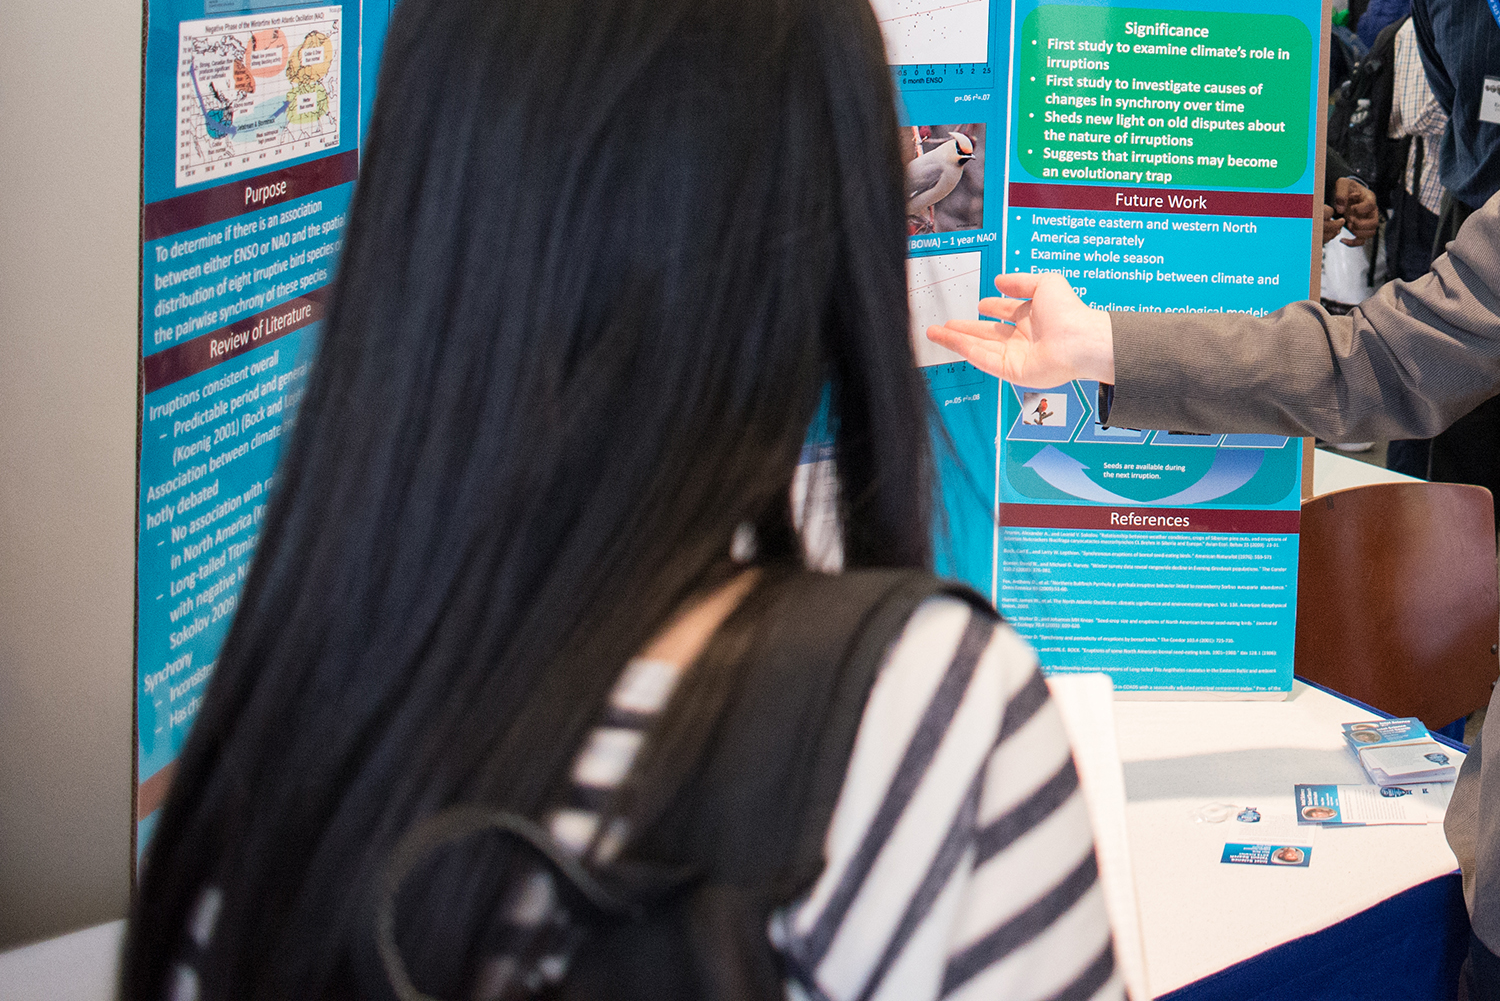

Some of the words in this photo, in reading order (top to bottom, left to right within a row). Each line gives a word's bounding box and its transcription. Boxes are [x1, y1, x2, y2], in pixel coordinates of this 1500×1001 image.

[1125, 21, 1208, 37] Significance
[1048, 38, 1075, 50] First
[1078, 40, 1113, 54] study
[1116, 42, 1130, 52] to
[1133, 43, 1187, 55] examine
[1250, 47, 1274, 59] role
[1278, 48, 1289, 59] in
[245, 181, 286, 204] Purpose
[1116, 193, 1163, 207] Future
[1168, 195, 1206, 208] Work
[155, 246, 168, 262] To
[170, 232, 222, 258] determine
[224, 224, 231, 241] if
[233, 221, 257, 238] there
[259, 217, 265, 230] is
[267, 215, 278, 228] an
[279, 200, 321, 224] association
[210, 331, 249, 358] Review
[252, 319, 263, 340] of
[265, 304, 310, 335] Literature
[1164, 464, 1185, 472] during
[1110, 512, 1189, 526] References
